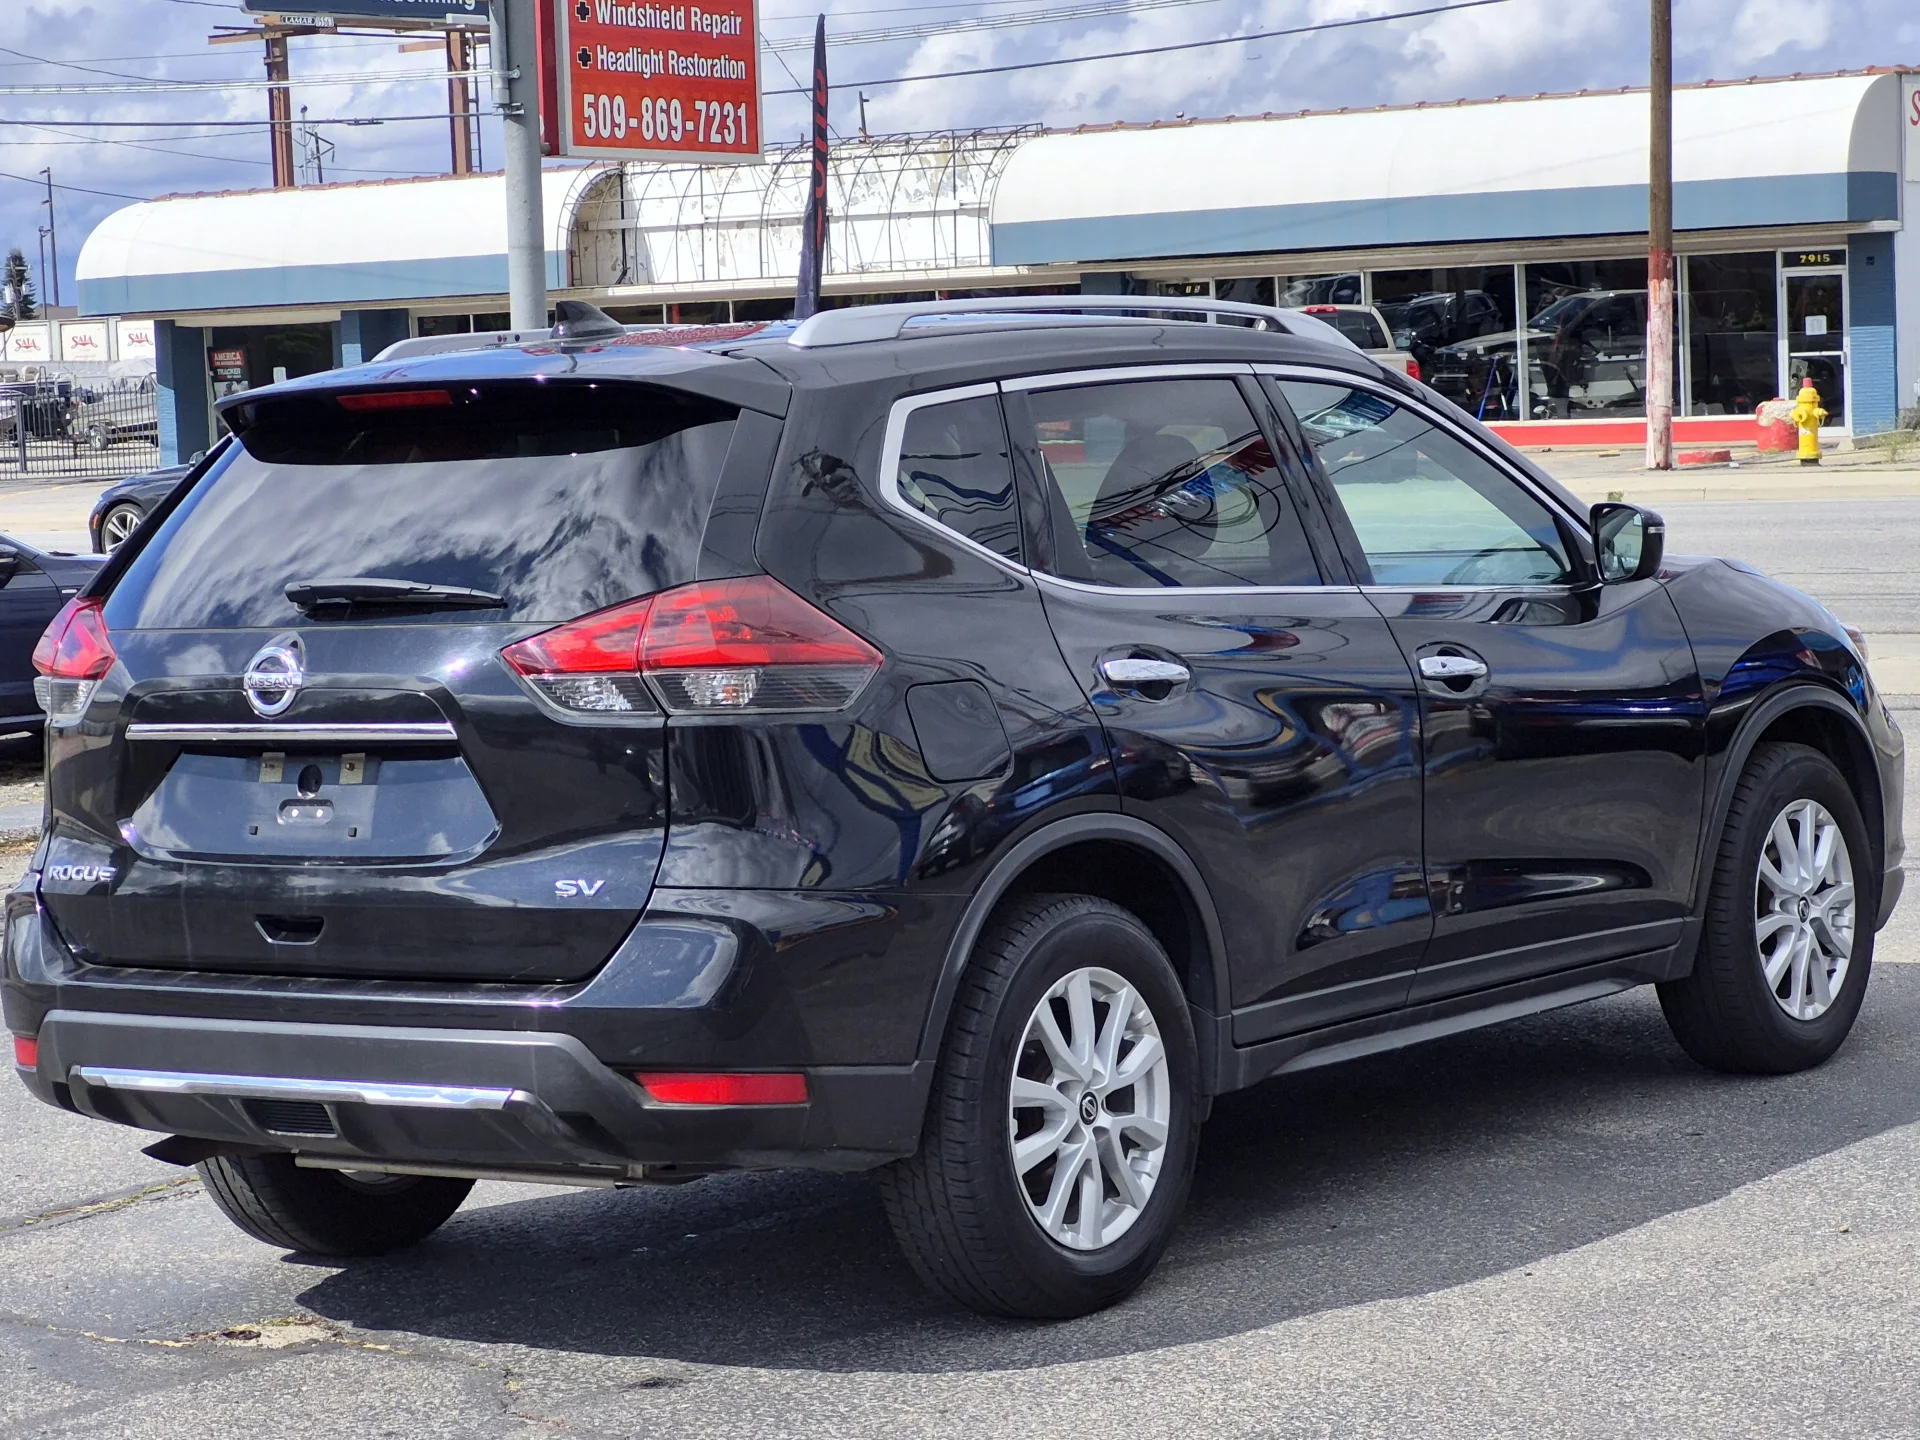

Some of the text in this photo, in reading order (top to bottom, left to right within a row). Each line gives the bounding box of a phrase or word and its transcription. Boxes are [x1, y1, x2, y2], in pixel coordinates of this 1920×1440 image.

[285, 16, 313, 25] LAMAR
[596, 0, 742, 38] Windshield Repair
[597, 45, 746, 79] Headlight Restoration
[583, 93, 748, 145] 509-869-7231
[1800, 254, 1831, 263] 7915
[15, 337, 41, 351] SAIA
[71, 335, 98, 349] SAIA
[127, 332, 153, 346] SAIA
[214, 351, 242, 361] AMERICA
[247, 675, 293, 688] NISSAN
[48, 864, 117, 883] ROGUE
[554, 879, 606, 897] SV
